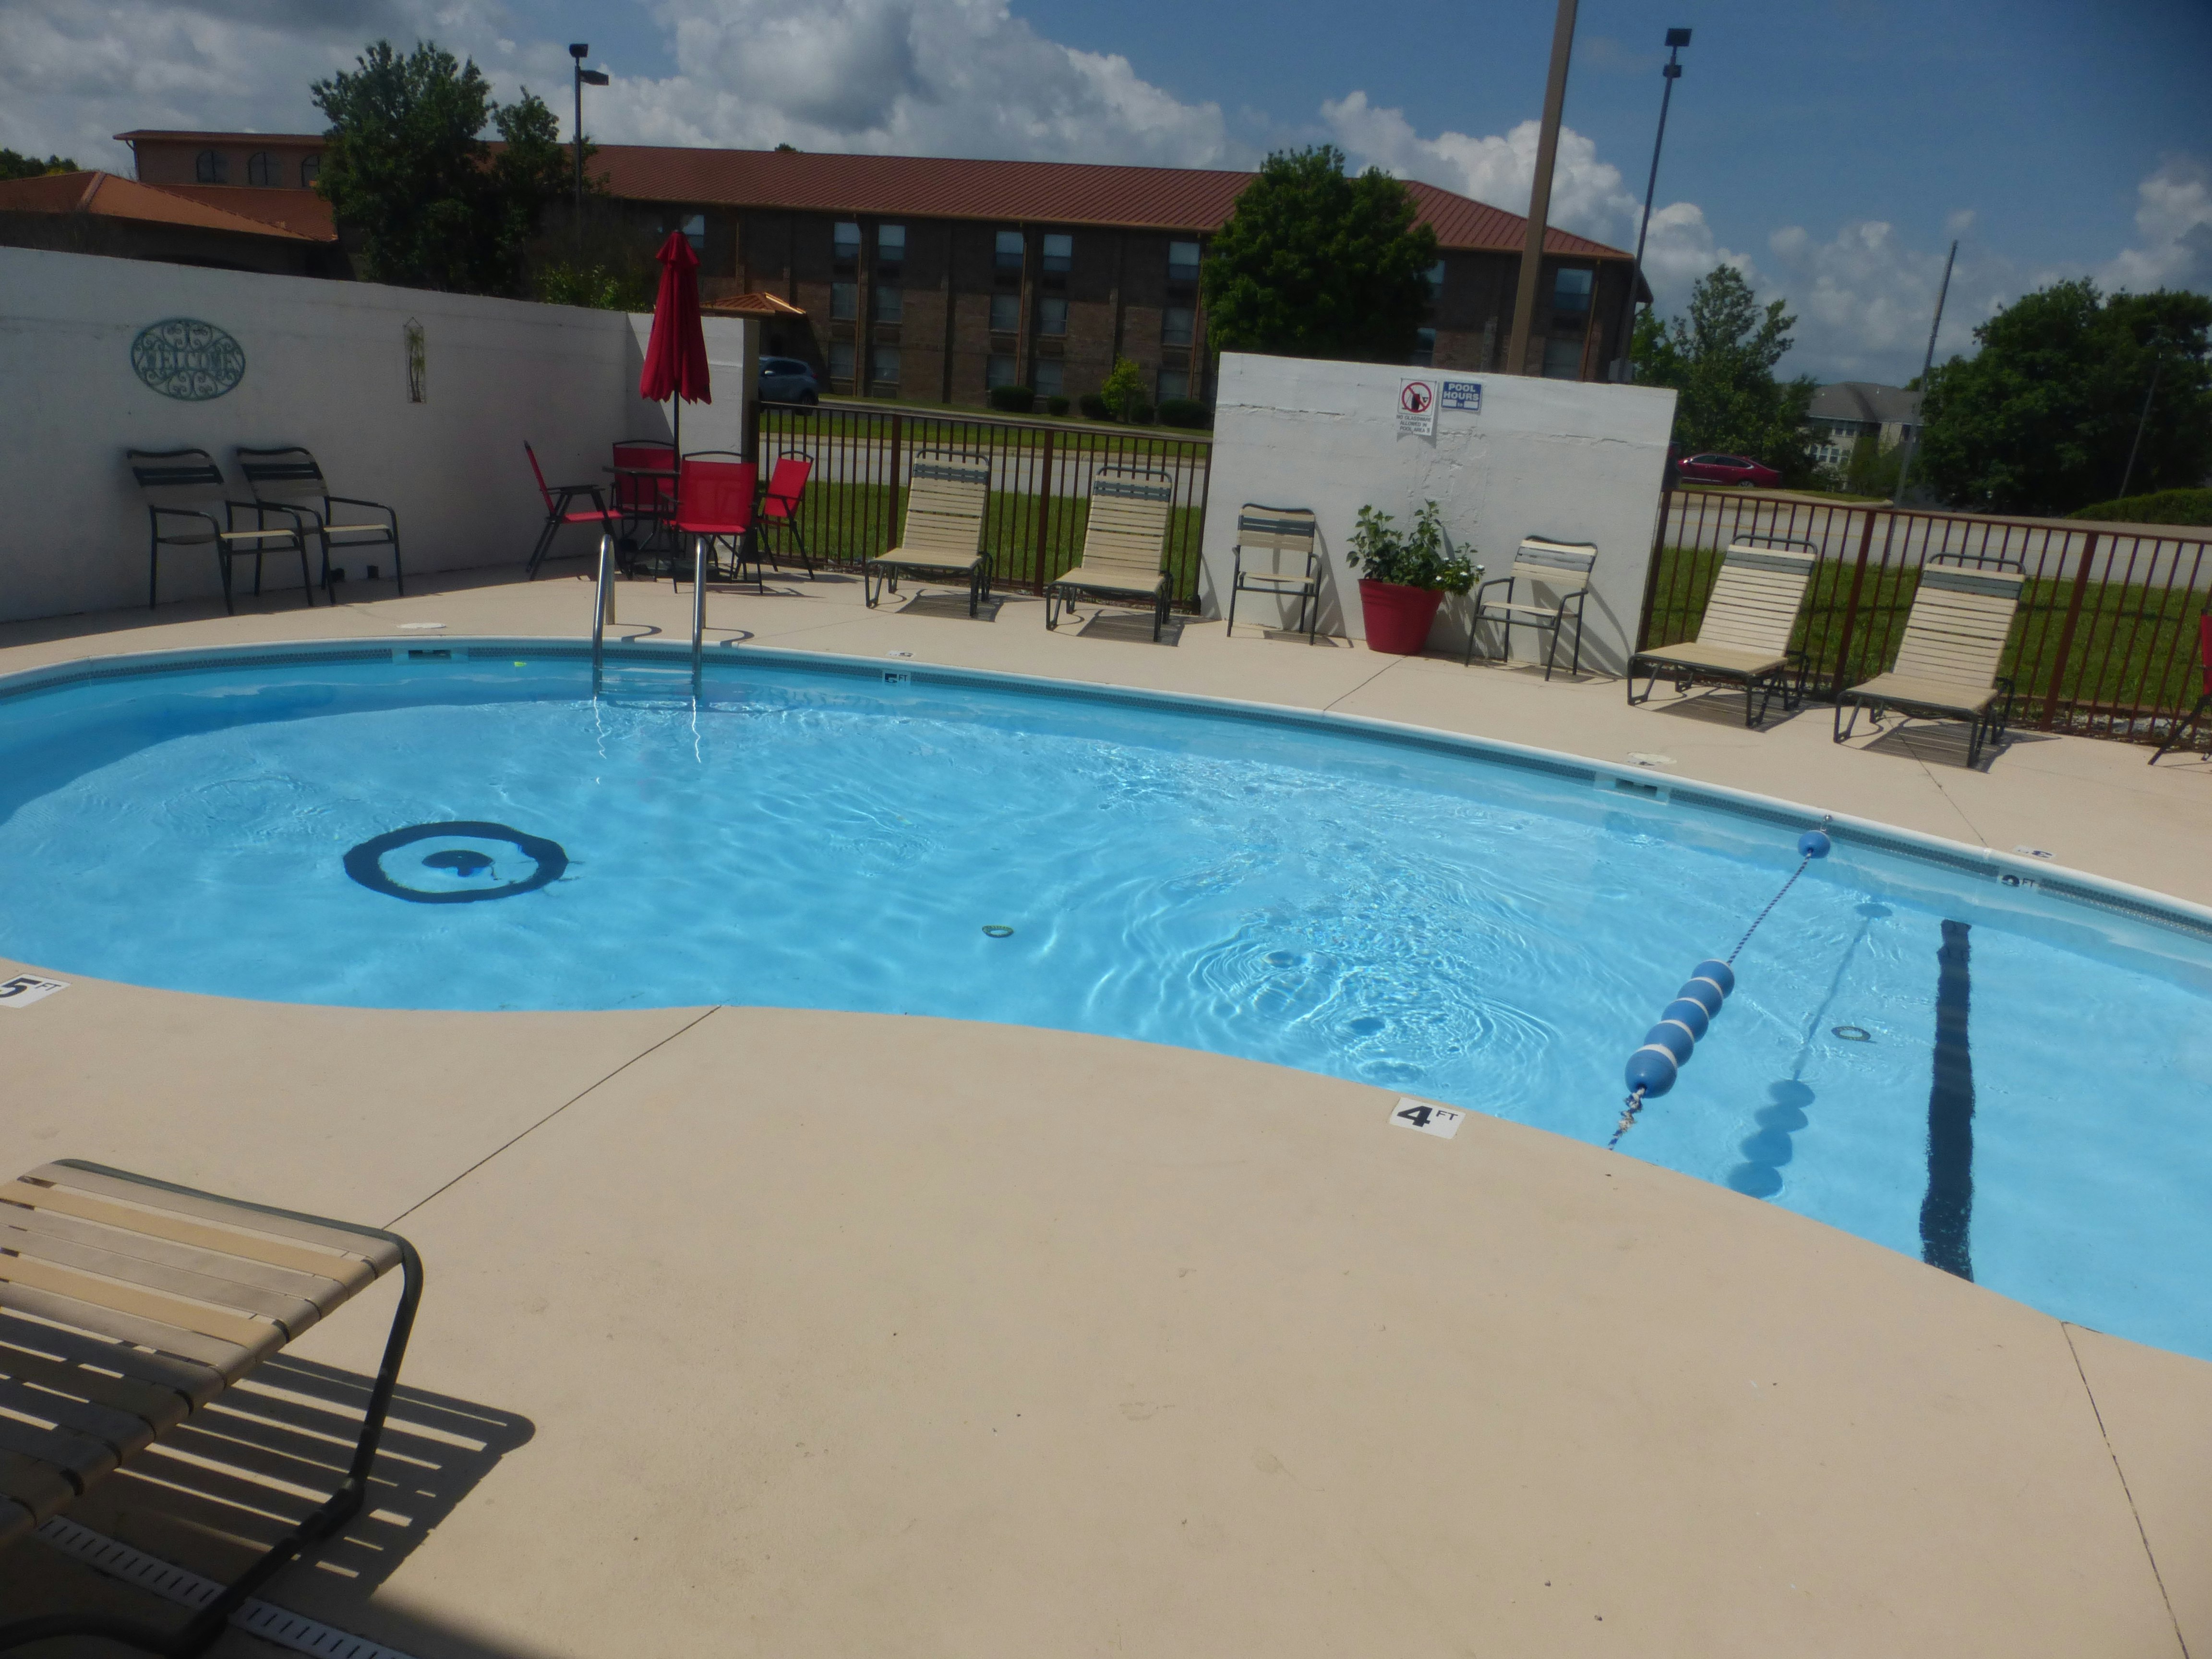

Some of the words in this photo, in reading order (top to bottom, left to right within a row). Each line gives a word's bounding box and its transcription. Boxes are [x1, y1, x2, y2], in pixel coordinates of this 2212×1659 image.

[1448, 383, 1476, 392] POOL
[1443, 391, 1479, 400] HOURS
[0, 977, 42, 998] 5
[35, 982, 61, 991] FT
[1397, 1106, 1432, 1127] 4
[1436, 1110, 1458, 1120] FT
